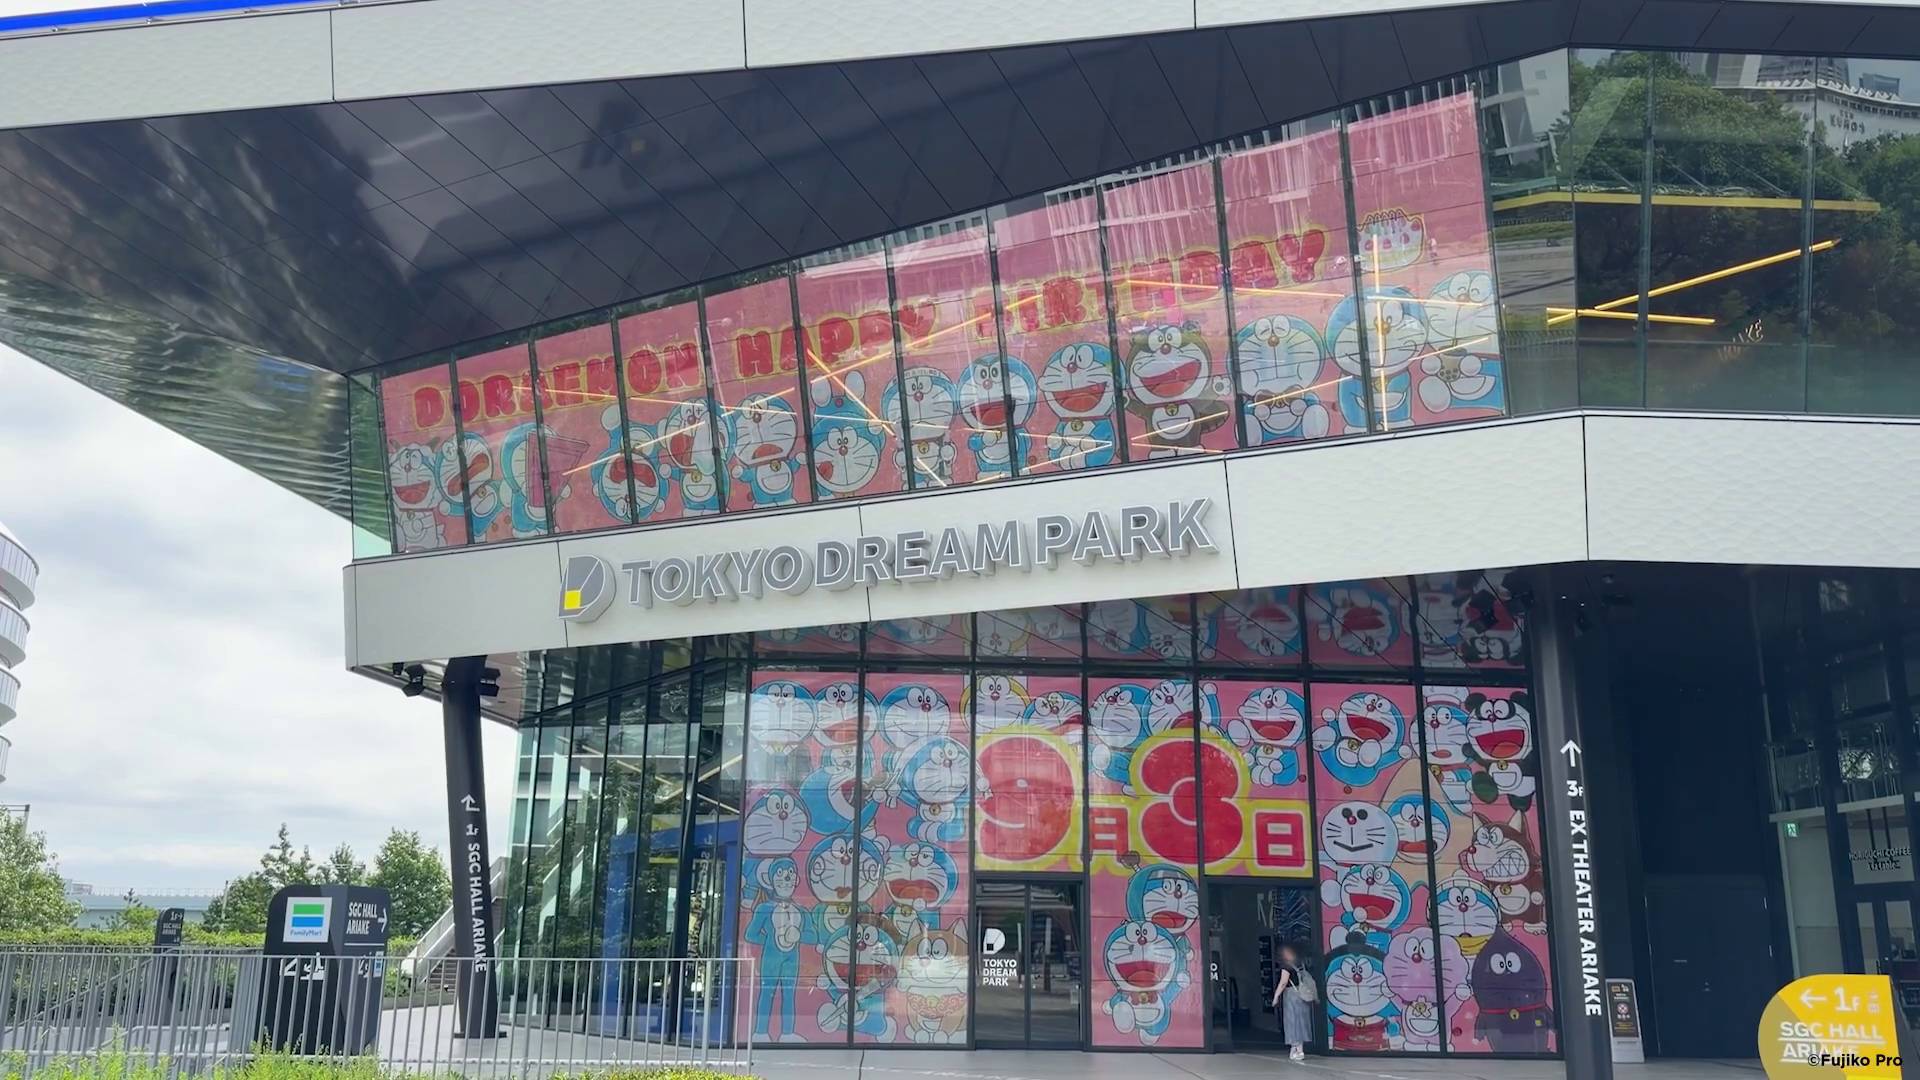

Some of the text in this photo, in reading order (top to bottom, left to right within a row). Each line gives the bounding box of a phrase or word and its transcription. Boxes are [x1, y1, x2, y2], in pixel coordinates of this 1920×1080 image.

[737, 302, 936, 377] HAPPY
[973, 229, 1326, 338] BIRTHDAY
[622, 546, 810, 606] TOKYO
[815, 520, 1022, 587] DREAM
[1036, 497, 1220, 565] PARK
[348, 902, 377, 918] SGC HALL
[468, 843, 488, 973] SGC HALL ARIAKE
[1569, 809, 1602, 1016] EX THEATER ARIAKE
[346, 919, 370, 935] ARIAKE
[983, 959, 1017, 967] TOKYO
[983, 968, 1017, 977] DREAM
[982, 977, 1009, 986] PARK
[1834, 986, 1861, 1012] 1F
[1780, 1021, 1884, 1040] SGC HALL
